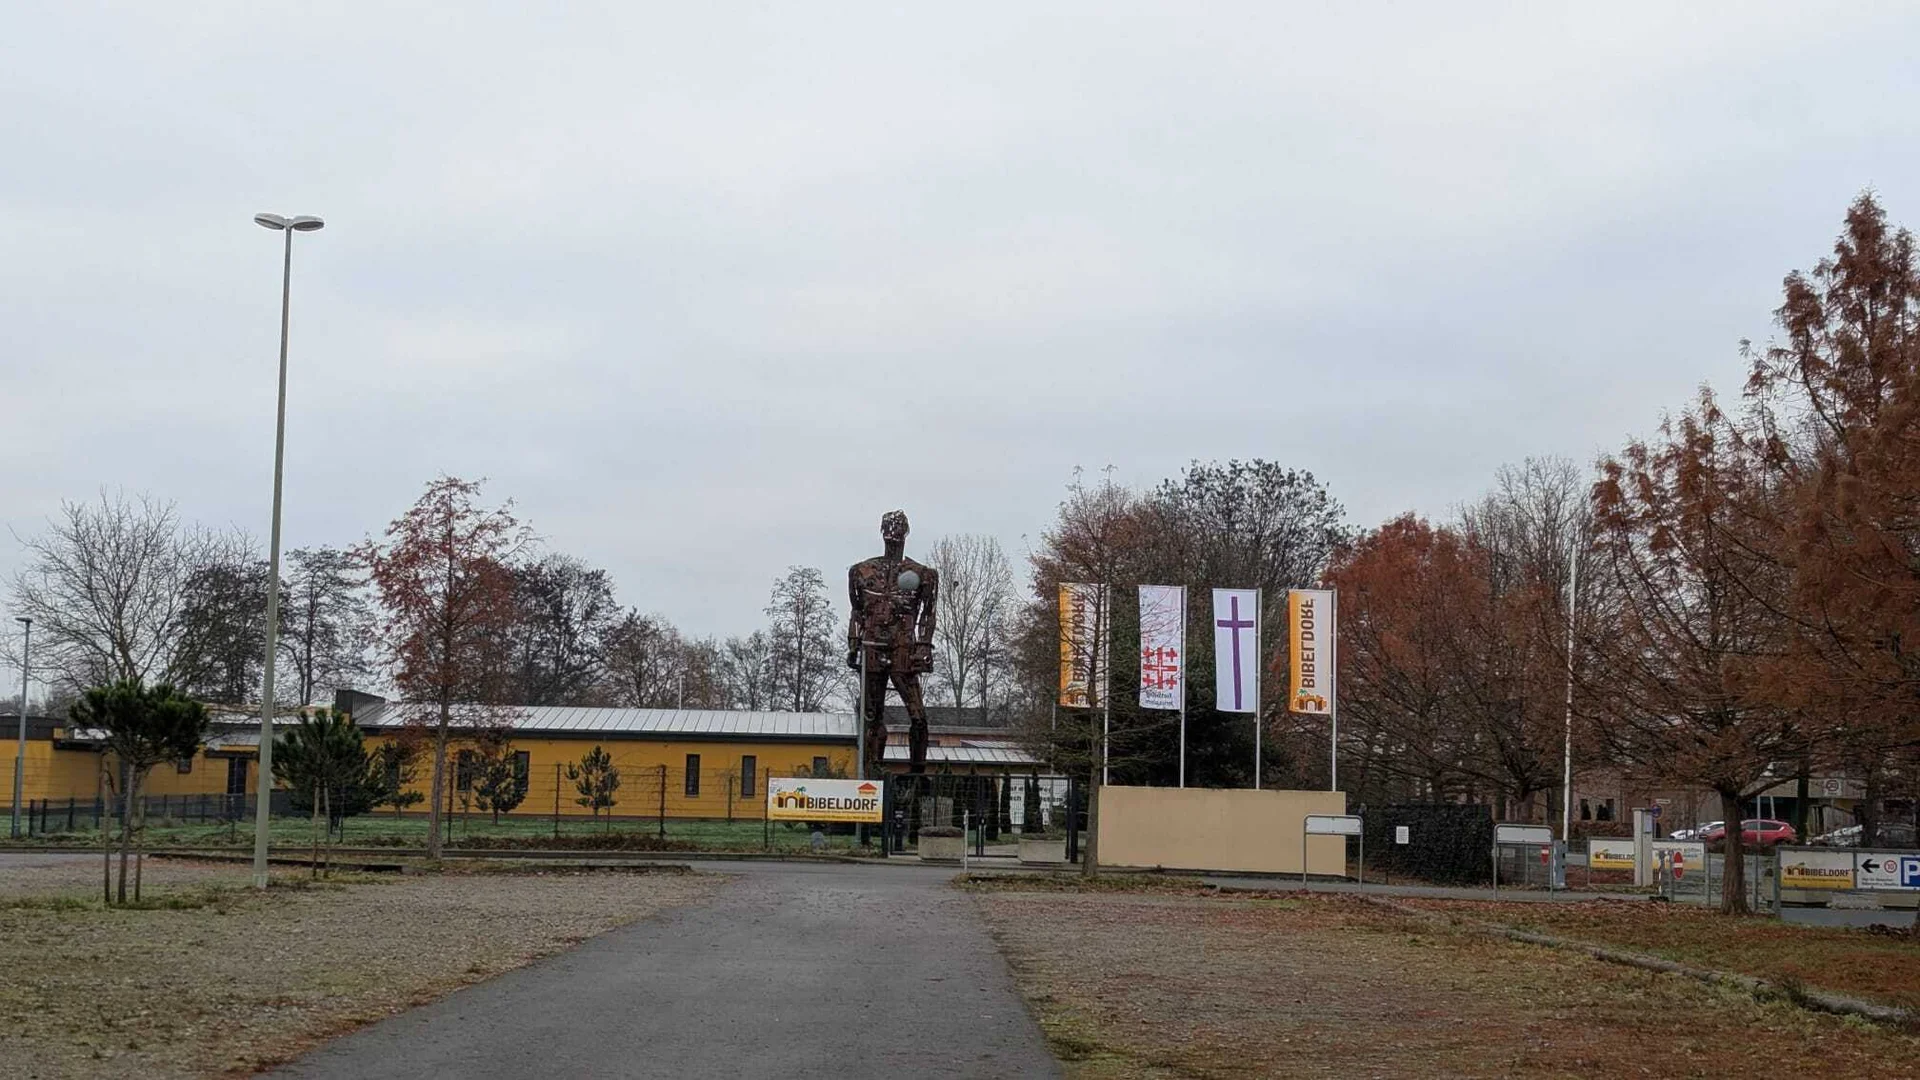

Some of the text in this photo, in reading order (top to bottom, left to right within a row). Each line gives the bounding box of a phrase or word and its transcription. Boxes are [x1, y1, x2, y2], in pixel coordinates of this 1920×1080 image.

[807, 797, 879, 810] BIBELDORF
[1805, 868, 1850, 876] BIBELDORF
[1903, 861, 1920, 884] P
